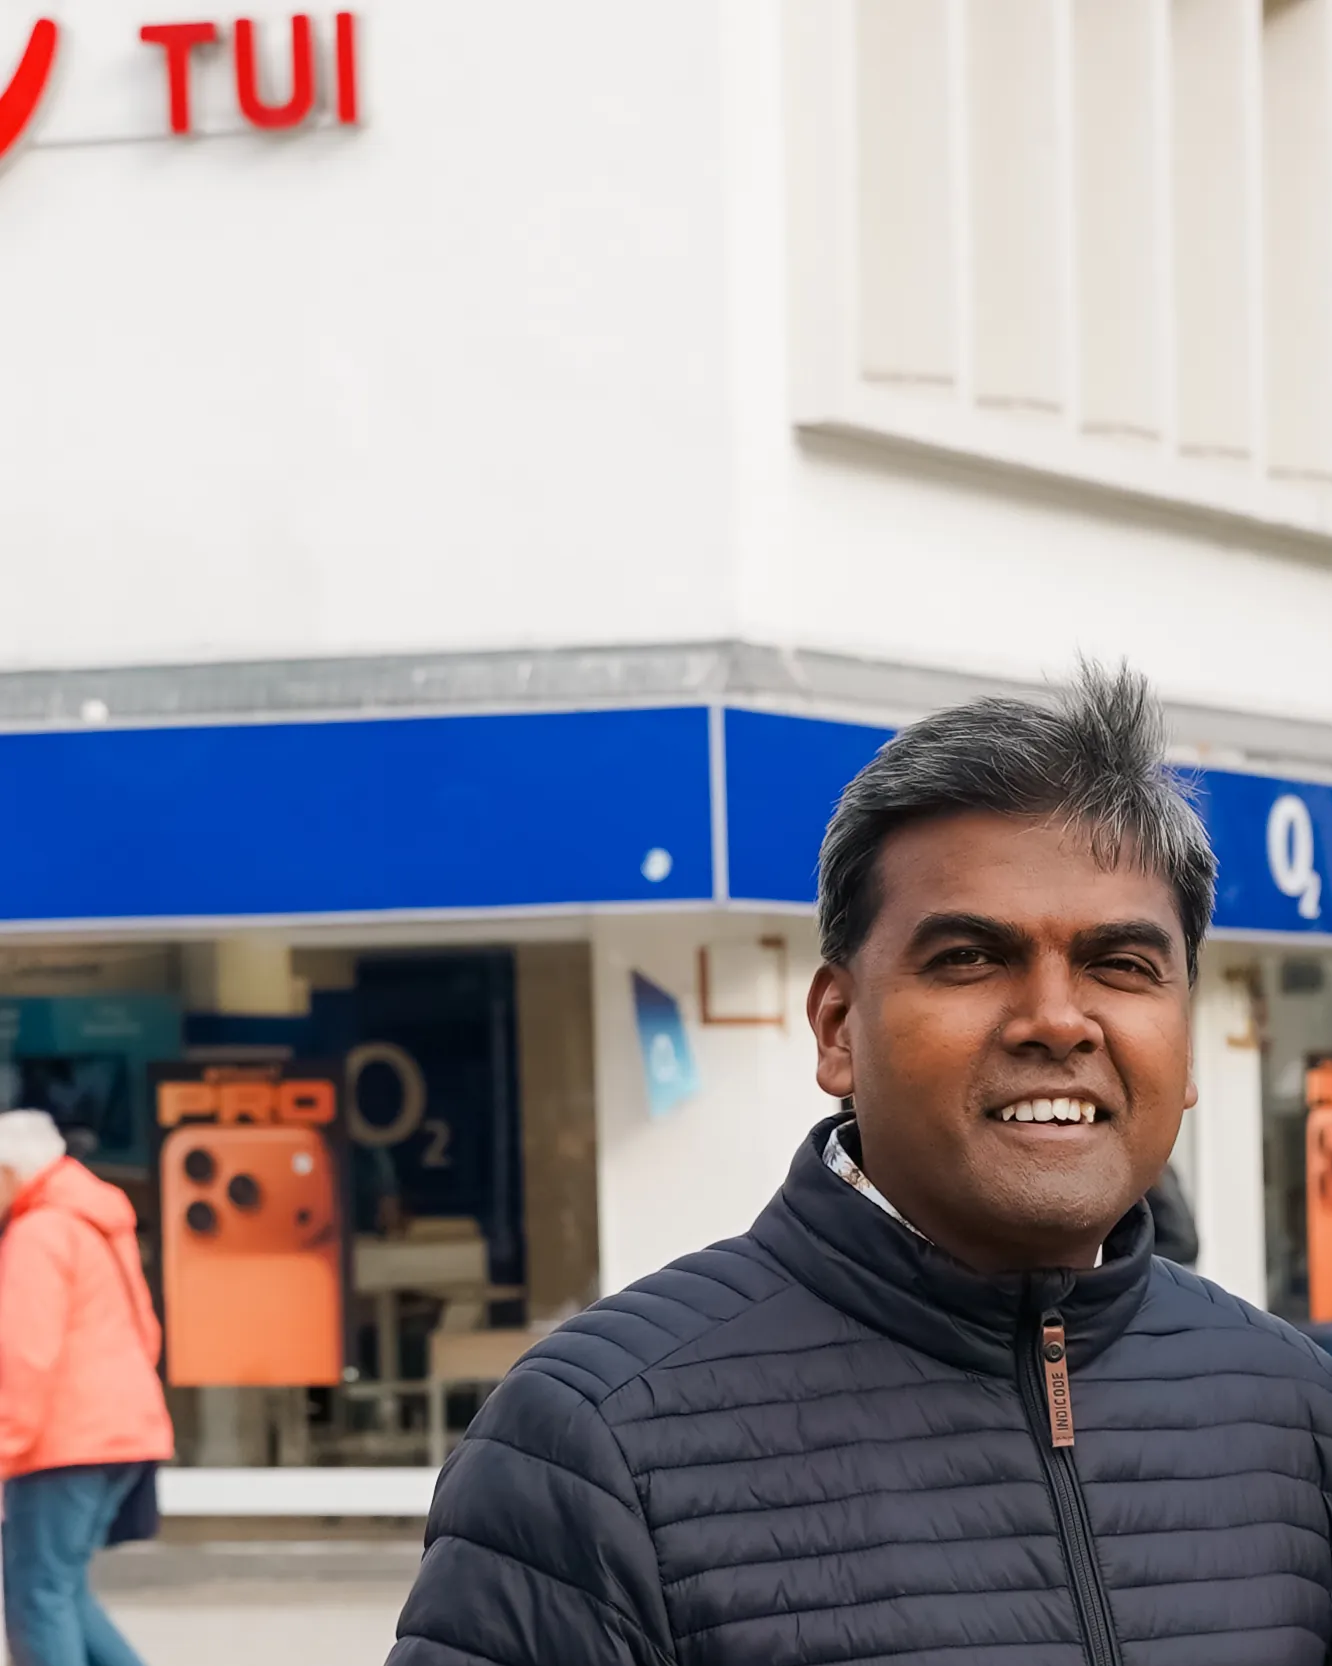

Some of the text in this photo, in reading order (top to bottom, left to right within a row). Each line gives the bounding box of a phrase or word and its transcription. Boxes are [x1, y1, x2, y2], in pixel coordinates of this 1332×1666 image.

[140, 12, 356, 134] TUI
[158, 1080, 336, 1127] PRO
[1052, 1372, 1069, 1431] INDICODE
